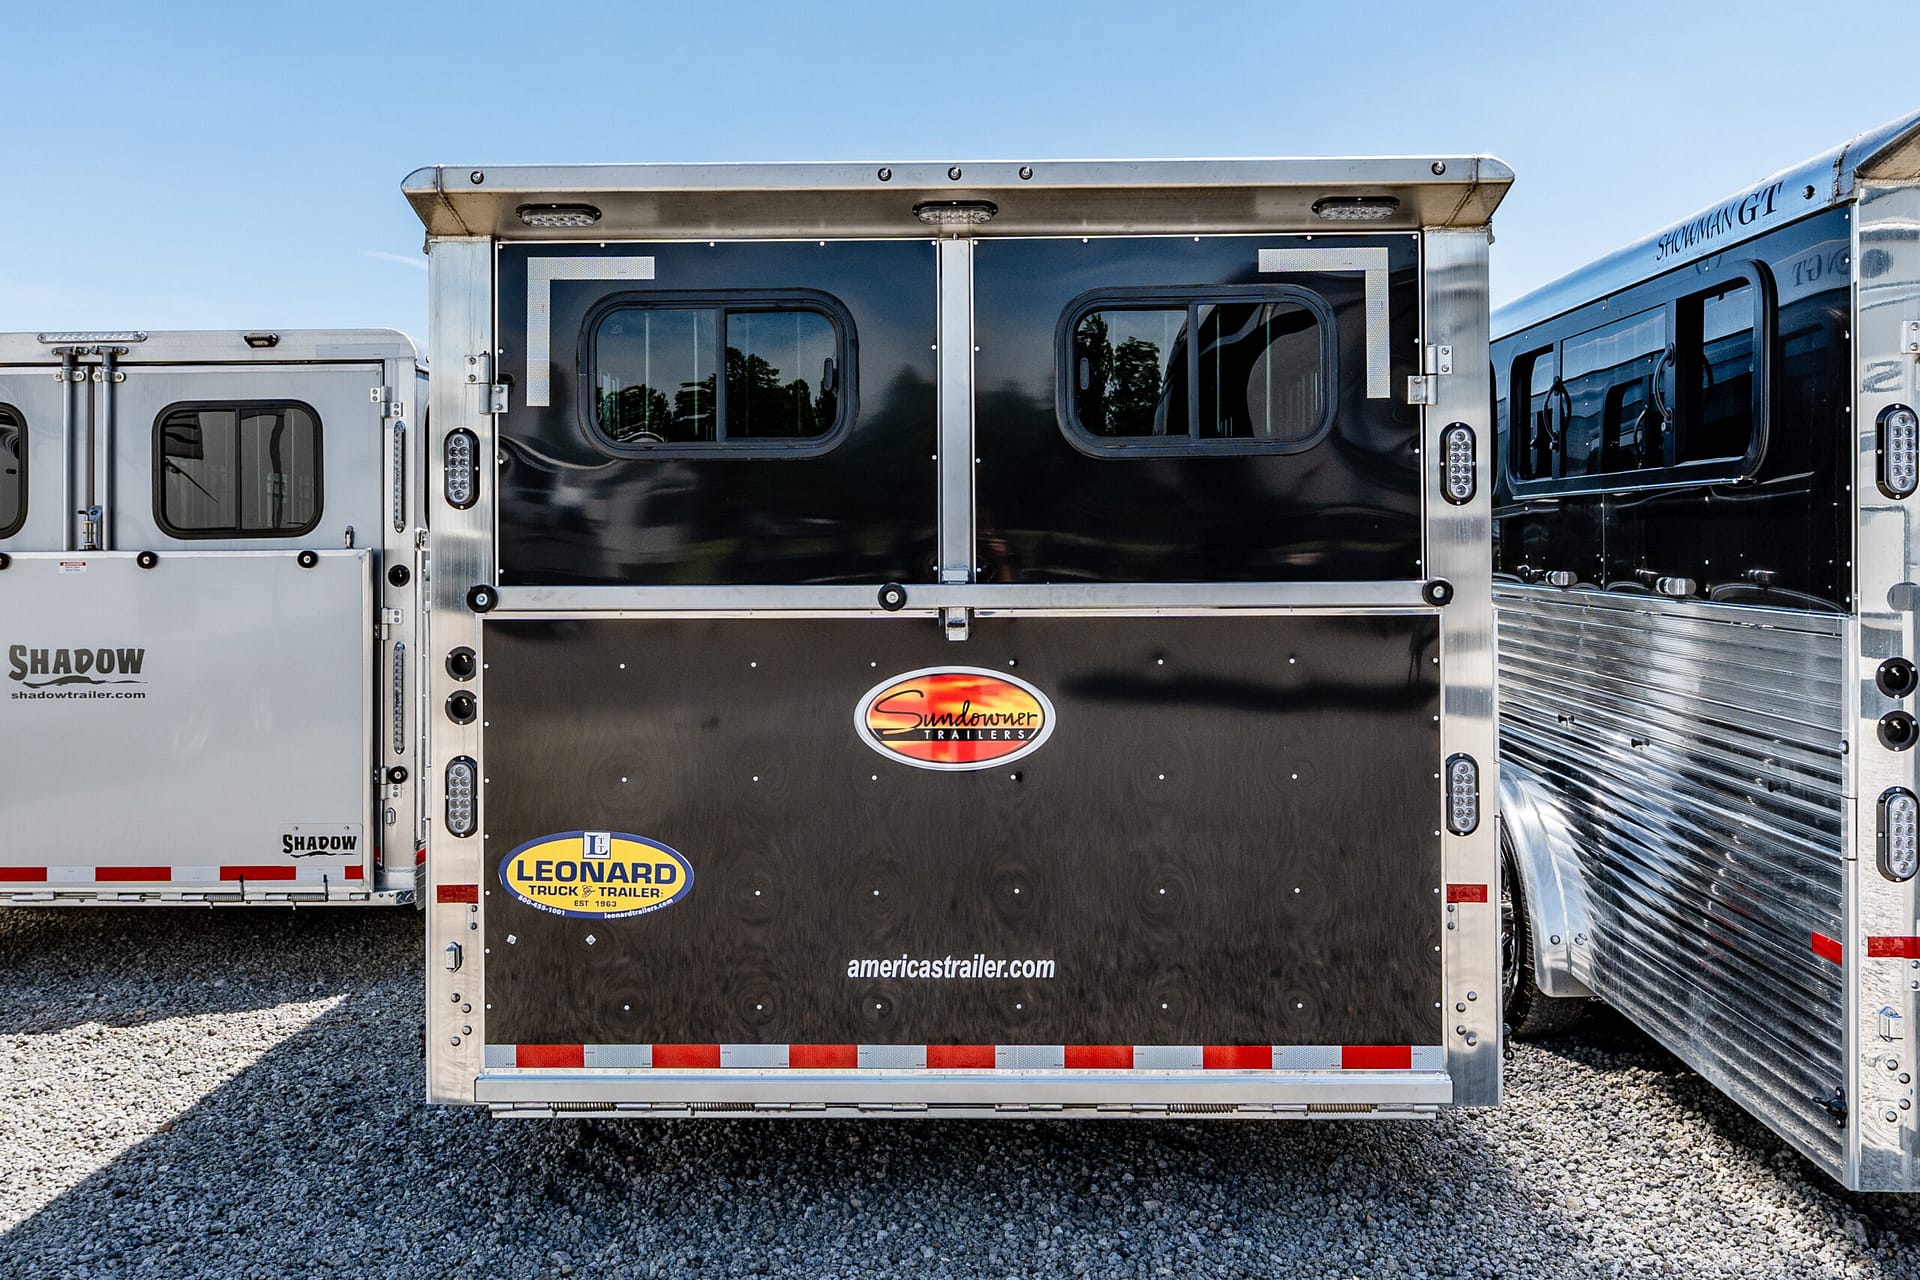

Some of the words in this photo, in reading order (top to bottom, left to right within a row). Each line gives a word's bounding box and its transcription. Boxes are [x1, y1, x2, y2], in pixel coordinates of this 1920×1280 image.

[1656, 202, 1736, 261] SHOWMAN
[1738, 181, 1784, 226] GT
[8, 645, 145, 681] SHADOW
[11, 691, 146, 699] shadowtrailer.com
[875, 690, 1038, 734] Sundowner
[924, 730, 1025, 740] TRAILERS
[282, 834, 357, 854] SHADOW
[517, 860, 677, 884] LEONARD
[528, 885, 578, 896] TRUCK
[599, 886, 660, 898] TRAILER
[604, 899, 674, 919] leonardtrailers.com
[847, 954, 1055, 978] americastrailer.com
